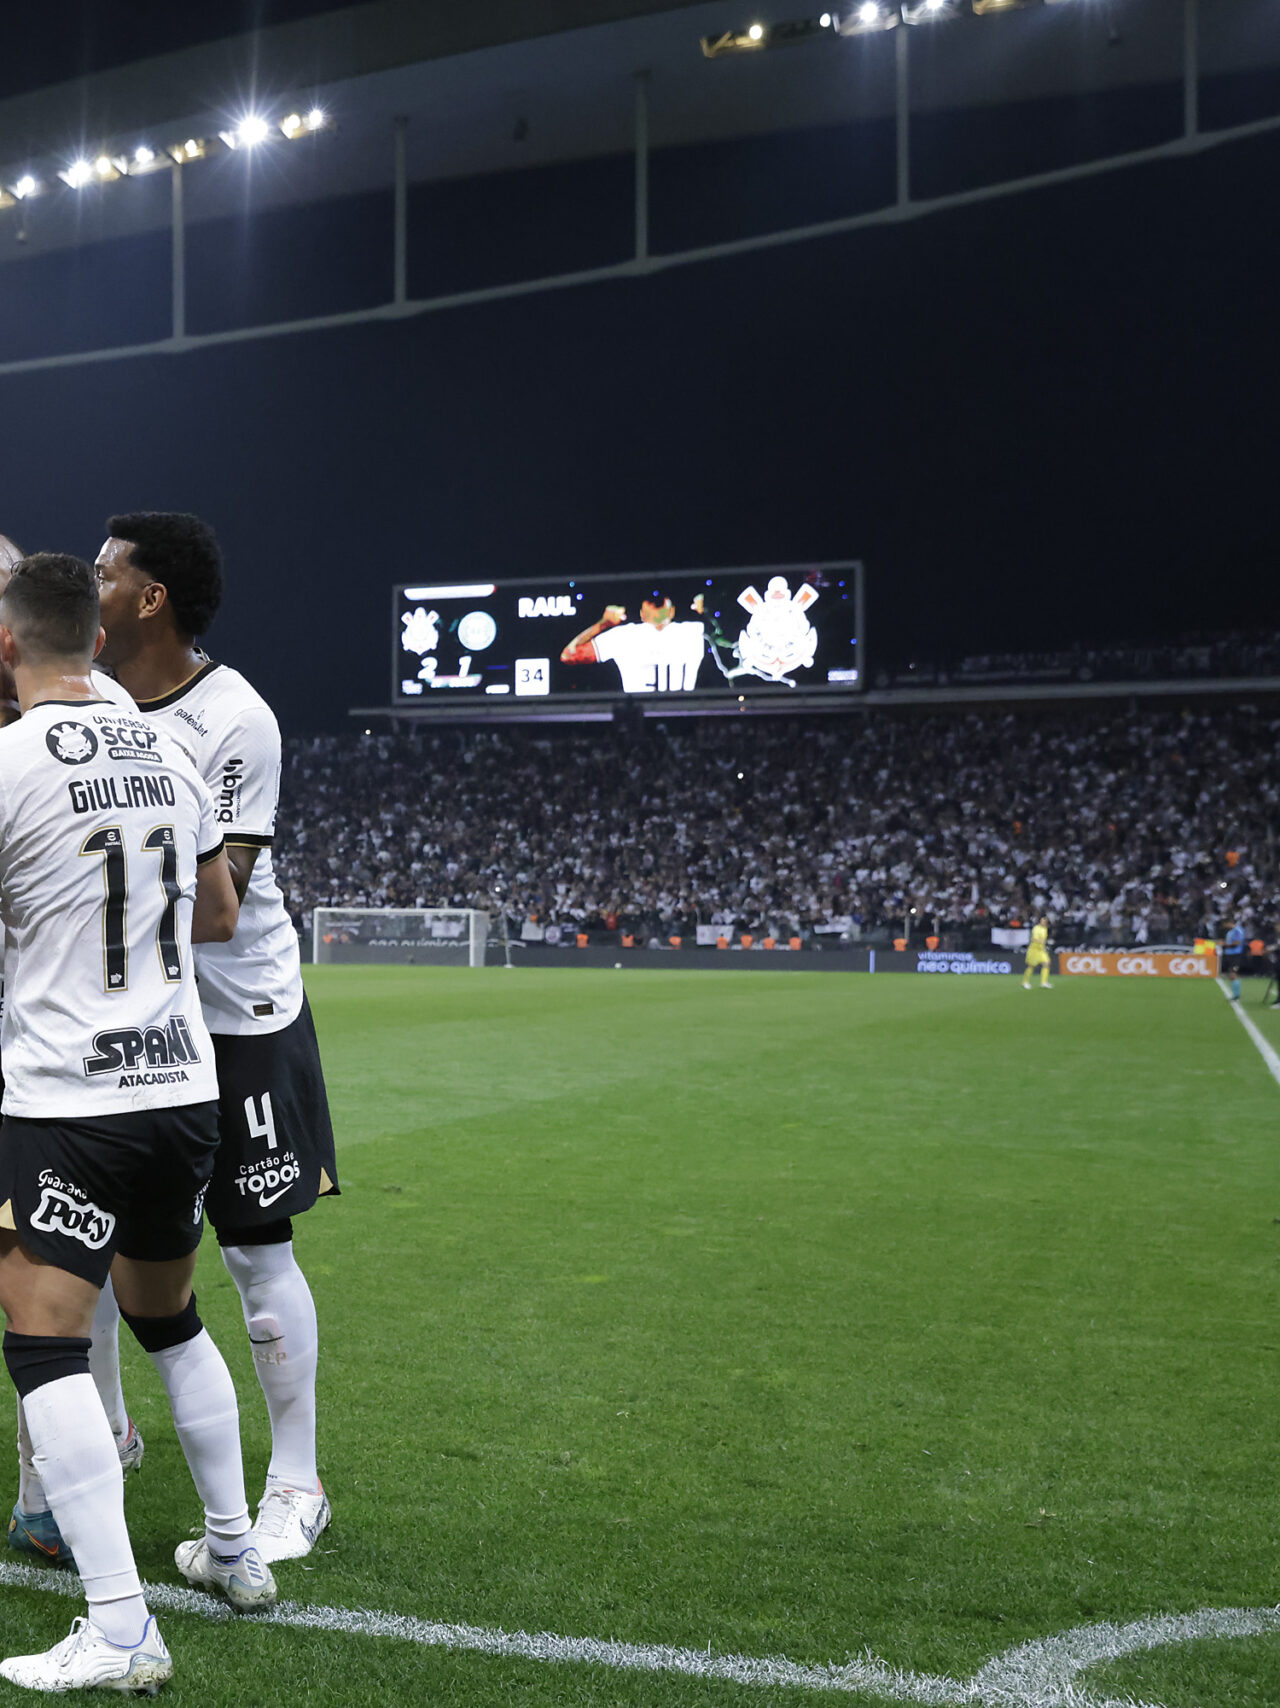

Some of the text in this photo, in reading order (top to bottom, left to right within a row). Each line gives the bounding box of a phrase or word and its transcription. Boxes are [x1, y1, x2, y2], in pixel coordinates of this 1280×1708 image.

[518, 595, 577, 618] RAUL
[417, 655, 472, 679] 2 1
[520, 668, 544, 683] 34
[100, 725, 158, 750] SCCP
[78, 824, 184, 994] 11
[917, 958, 1011, 975] neo química
[1066, 956, 1211, 976] GOL GOL GOL
[118, 1070, 190, 1089] ATACADISTA
[244, 1091, 278, 1150] 4
[239, 1151, 295, 1175] Cartão de
[234, 1160, 301, 1196] TODOS
[35, 1193, 112, 1245] Poty
